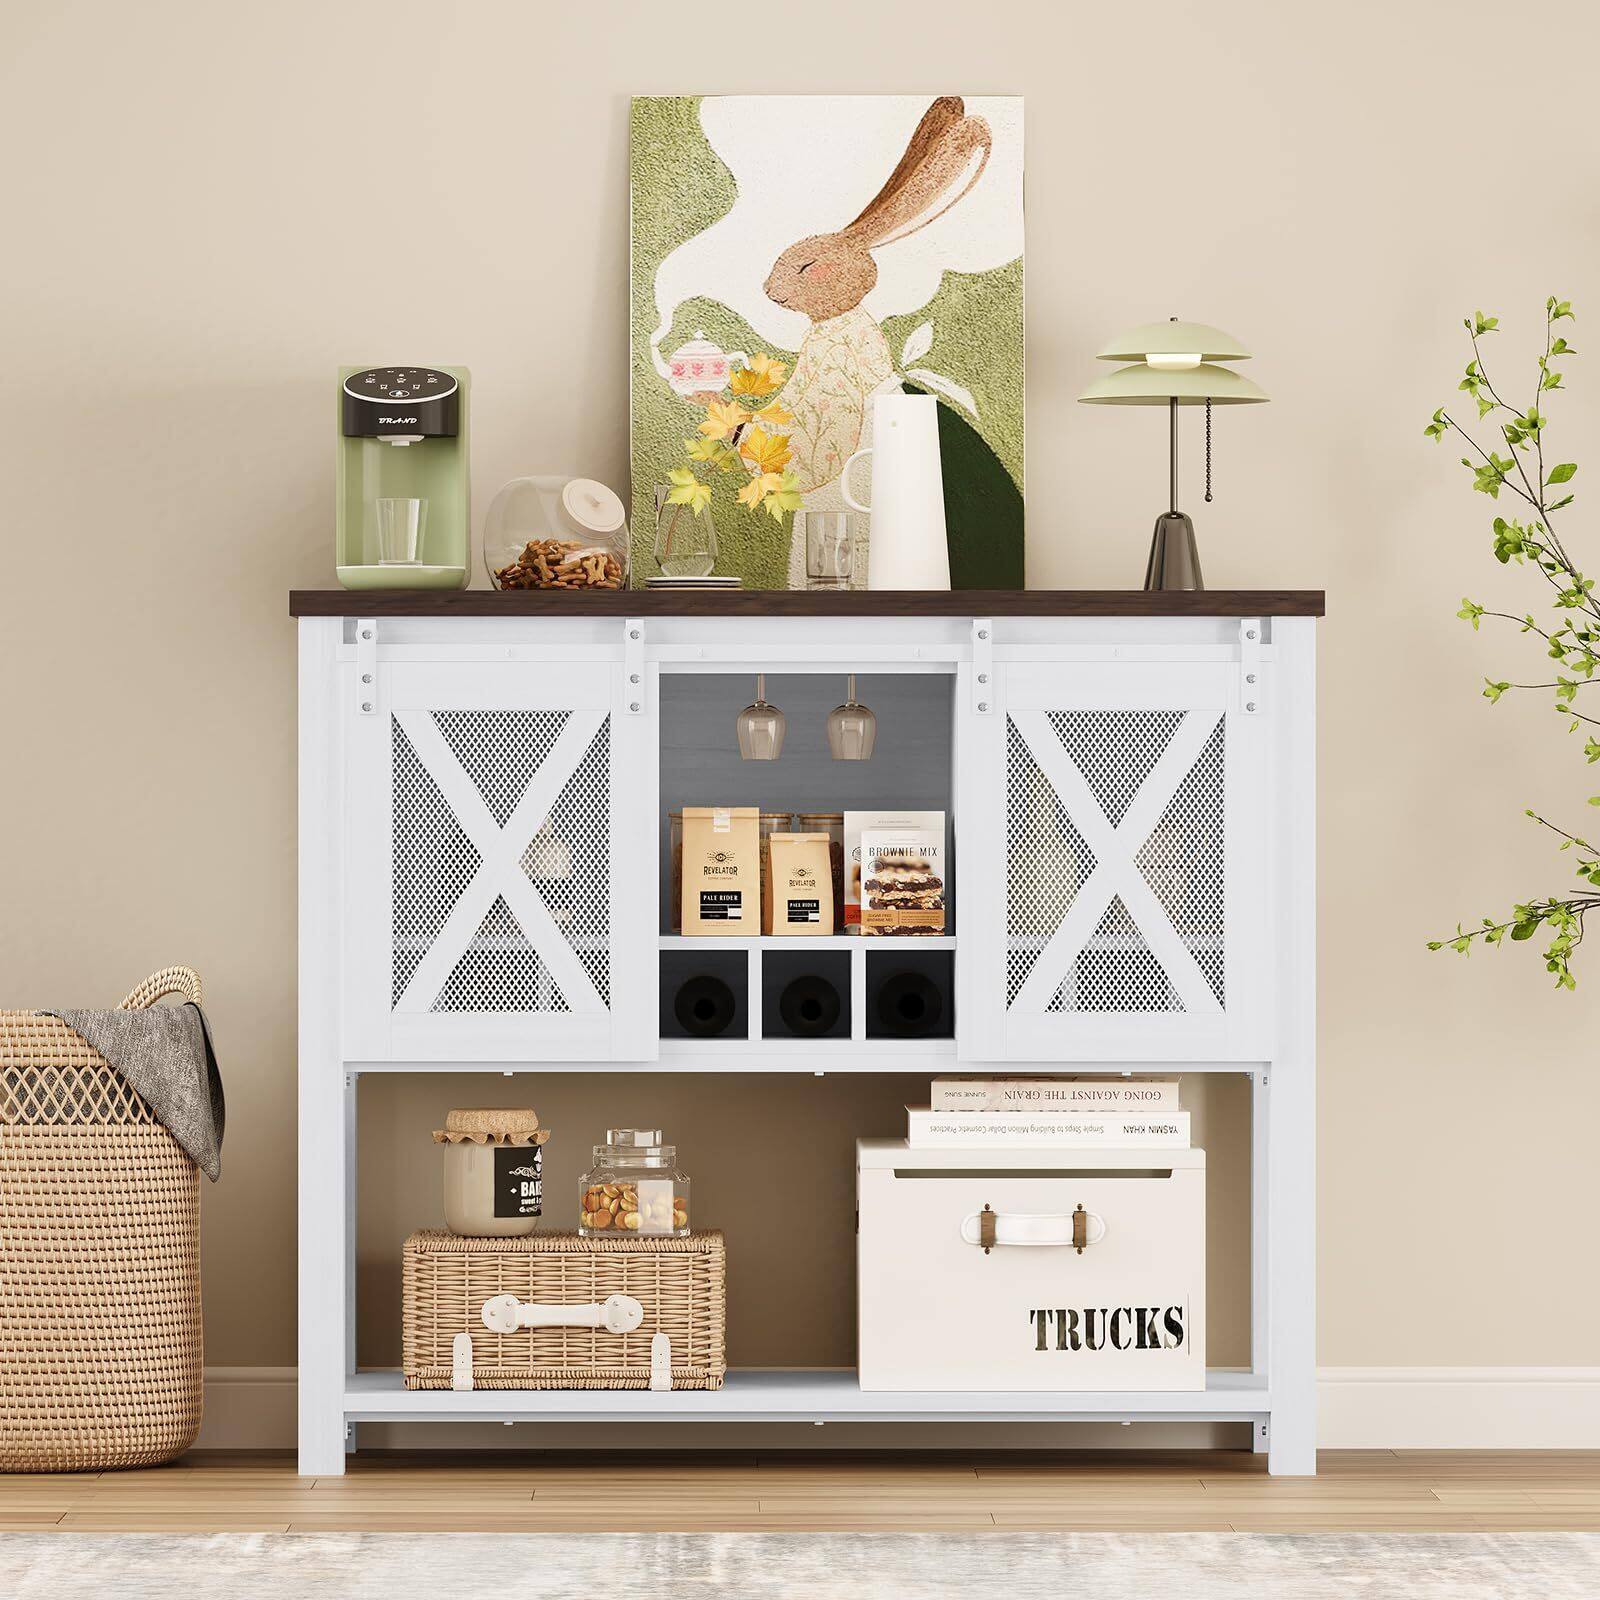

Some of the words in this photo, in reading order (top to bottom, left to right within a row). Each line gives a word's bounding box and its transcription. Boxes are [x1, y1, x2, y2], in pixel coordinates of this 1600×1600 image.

[378, 417, 418, 425] BRAND
[869, 846, 915, 857] BROWNIE
[919, 846, 938, 857] MIX
[703, 865, 739, 876] REVELATOR
[788, 879, 816, 888] REVELATOR
[1004, 1090, 1041, 1100] GRAIN
[1044, 1090, 1067, 1100] THE
[1070, 1090, 1121, 1101] AGAINST
[1124, 1090, 1162, 1101] GOING
[930, 1125, 957, 1134] Practices
[958, 1125, 987, 1134] Cosmetic
[988, 1125, 1007, 1134] Dollar
[1007, 1125, 1029, 1134] Million
[1030, 1123, 1056, 1134] Building
[1056, 1125, 1064, 1133] to
[1065, 1124, 1082, 1135] Steps
[1083, 1125, 1105, 1135] Simple
[1123, 1125, 1146, 1135] KHAN
[1148, 1125, 1179, 1135] YASMIN
[1029, 1305, 1184, 1352] TRUCKS
